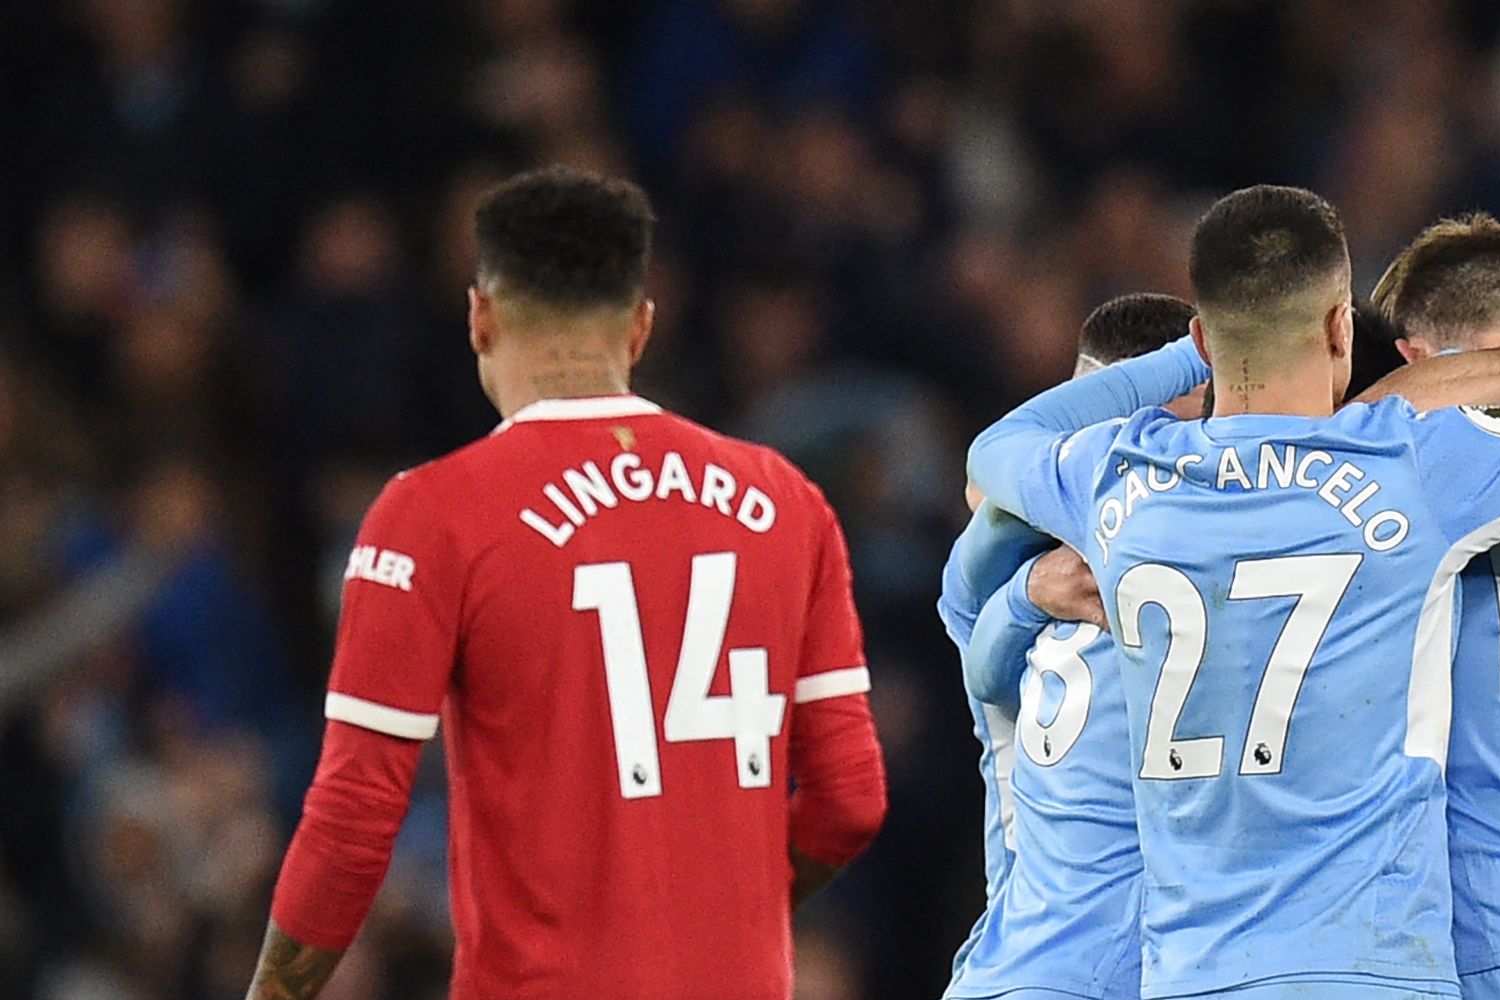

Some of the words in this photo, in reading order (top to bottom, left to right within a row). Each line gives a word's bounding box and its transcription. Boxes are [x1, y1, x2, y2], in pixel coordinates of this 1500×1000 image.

[519, 451, 776, 547] LINGARD
[1174, 443, 1410, 552] CANCELO
[572, 551, 787, 799] 14
[1018, 621, 1101, 768] 8
[1115, 552, 1365, 780] 27
